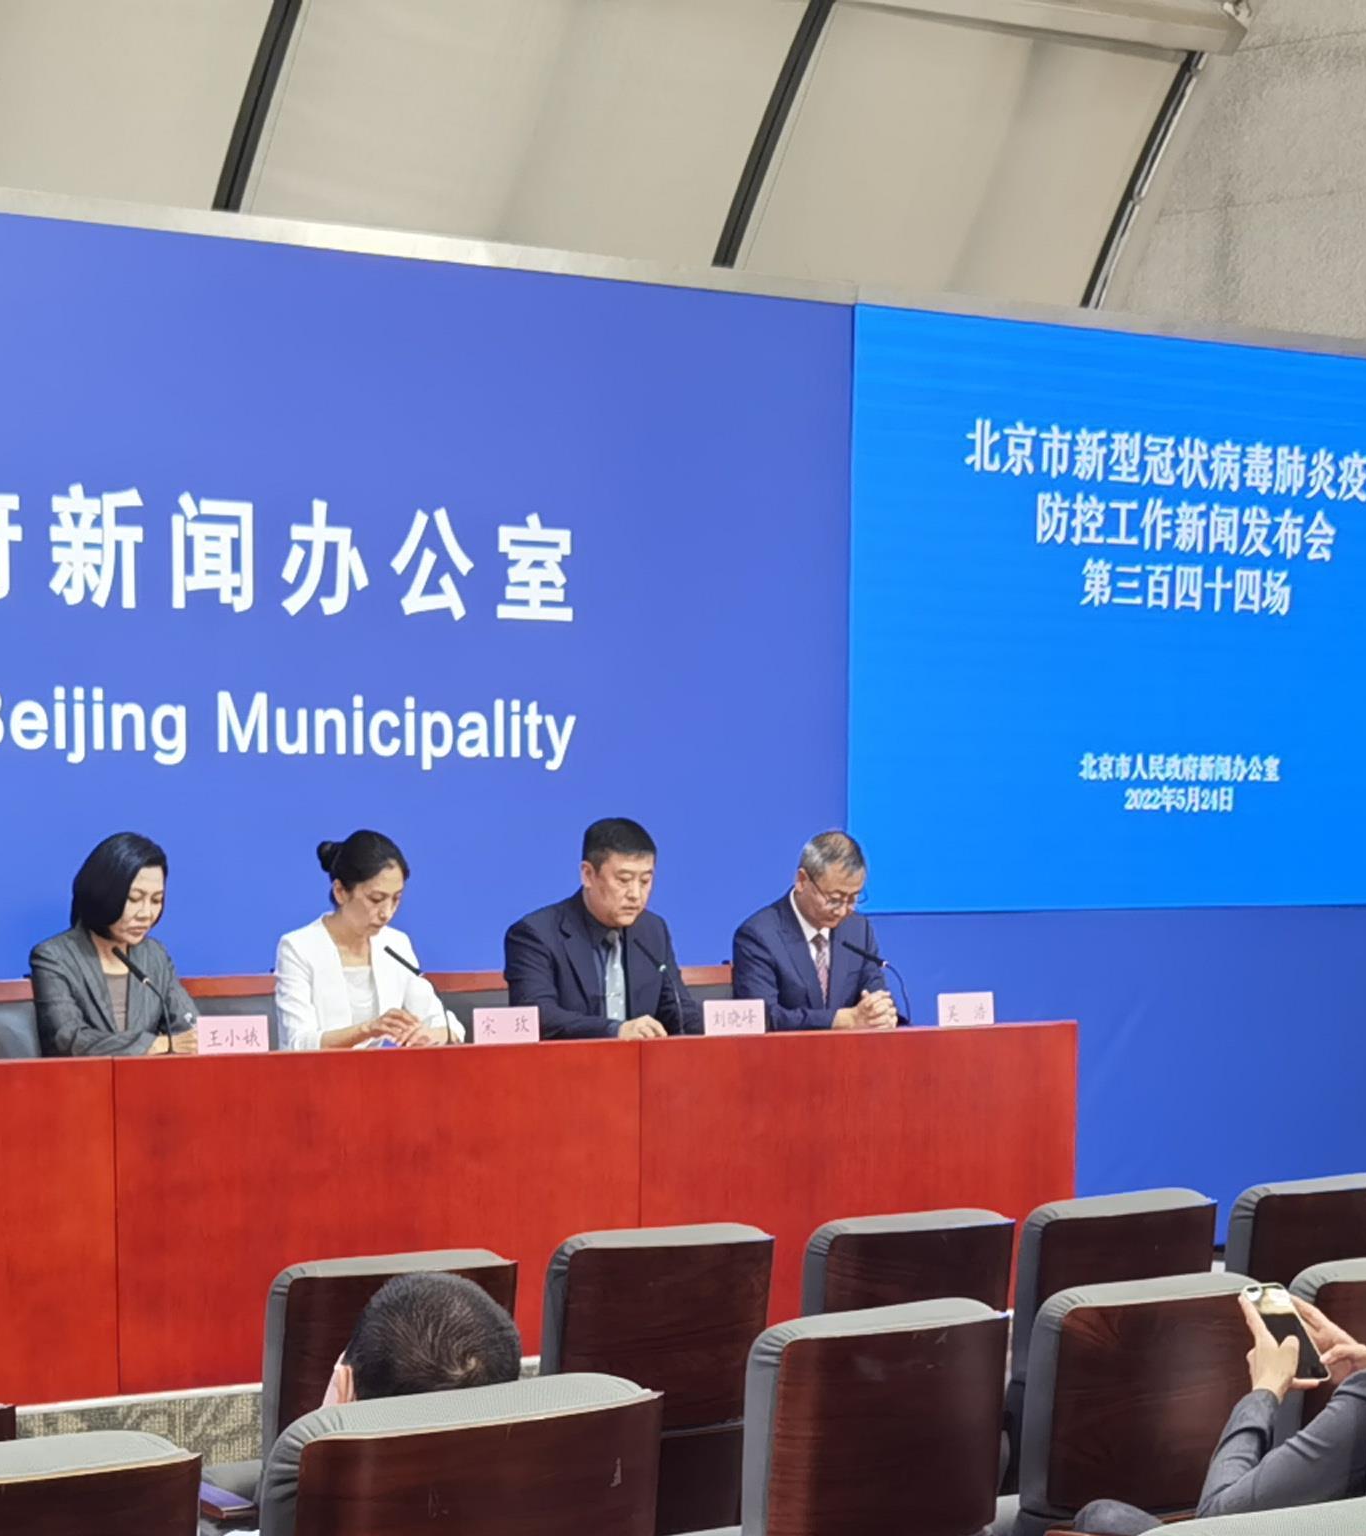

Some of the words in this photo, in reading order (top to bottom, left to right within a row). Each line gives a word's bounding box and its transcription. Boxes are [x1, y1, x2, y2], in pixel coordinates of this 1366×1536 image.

[1036, 492, 1336, 562] 防控工作新闻发布会
[1080, 557, 1291, 616] 第三百四十四场
[217, 691, 576, 771] Municipality
[1079, 753, 1280, 782] 北京市人民政府新闻办公室
[1124, 785, 1234, 813] 2022年5月24日
